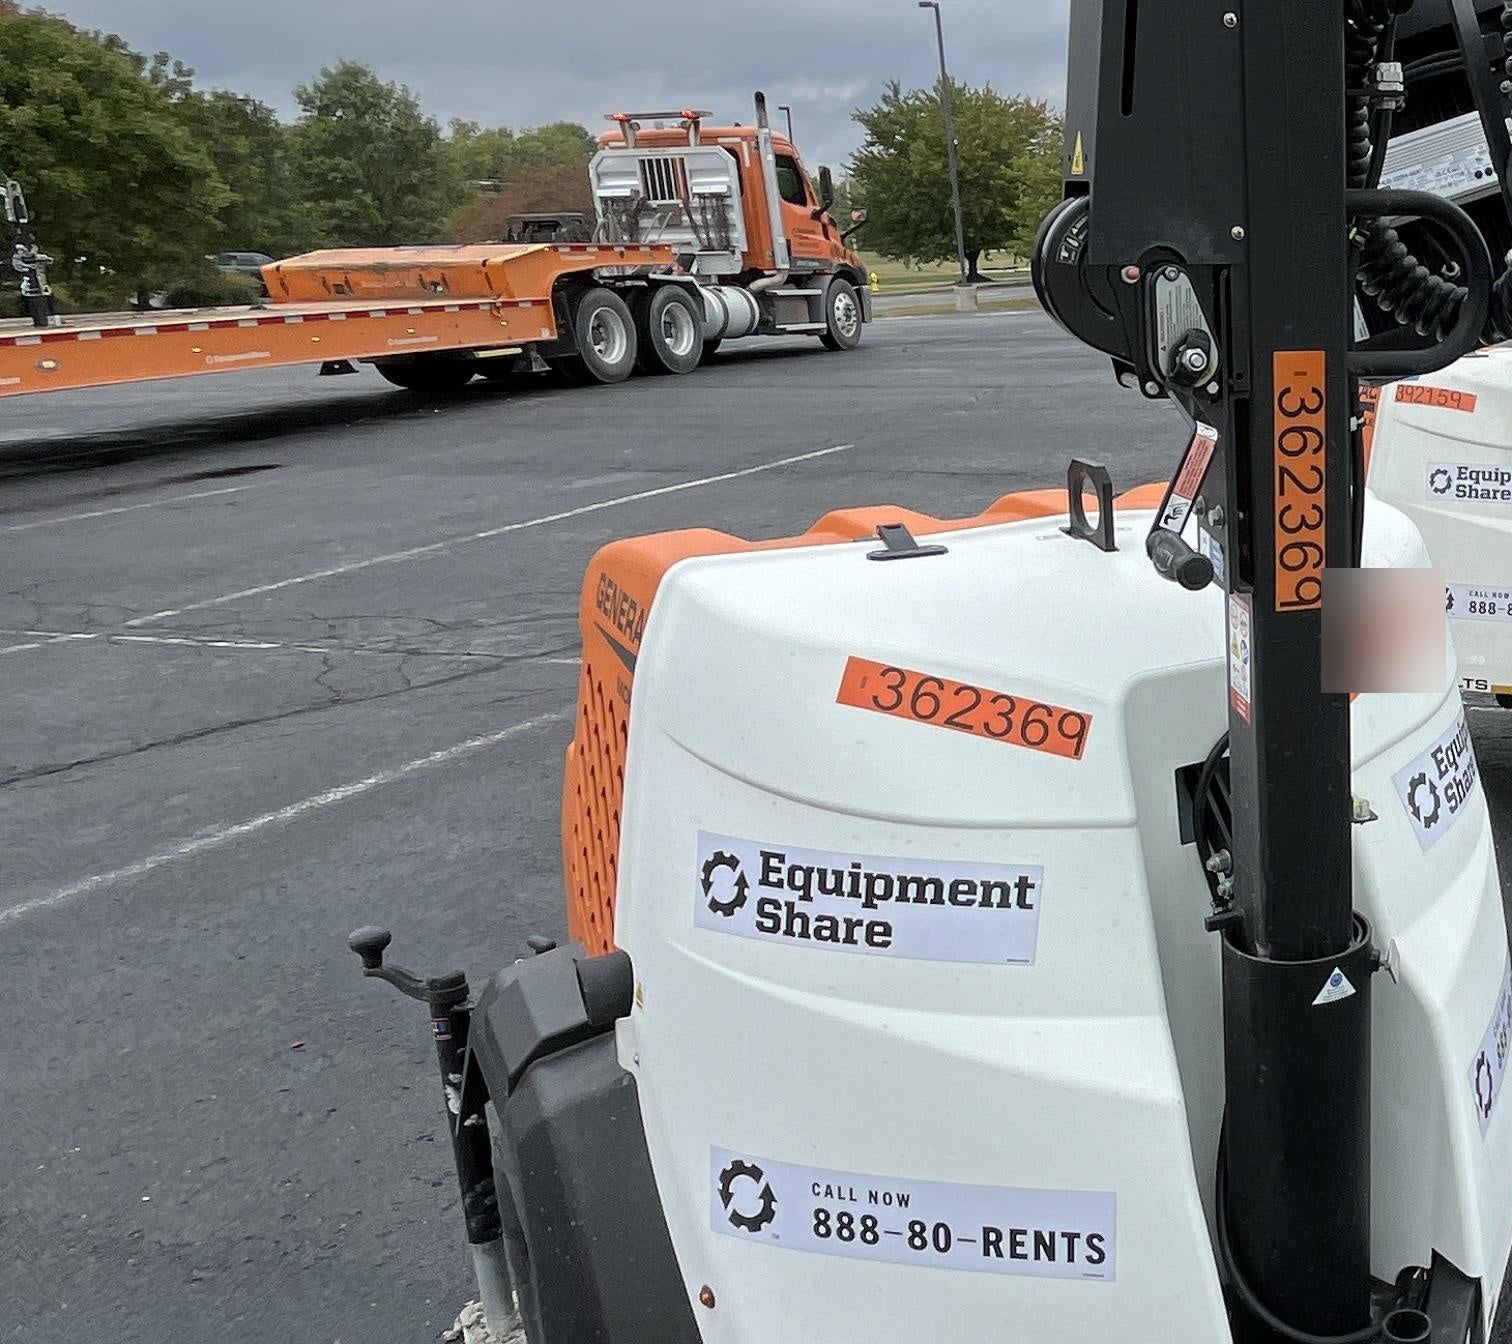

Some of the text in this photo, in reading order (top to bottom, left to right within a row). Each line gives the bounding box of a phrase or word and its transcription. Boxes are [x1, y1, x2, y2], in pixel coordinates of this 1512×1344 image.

[1277, 386, 1325, 609] 362369
[1455, 484, 1511, 501] Share
[872, 667, 1088, 758] 362369
[757, 849, 1036, 911] Equipment
[754, 896, 893, 949] Share
[812, 1182, 911, 1209] CALL NOW
[812, 1207, 1106, 1265] 888-80-RENTS
